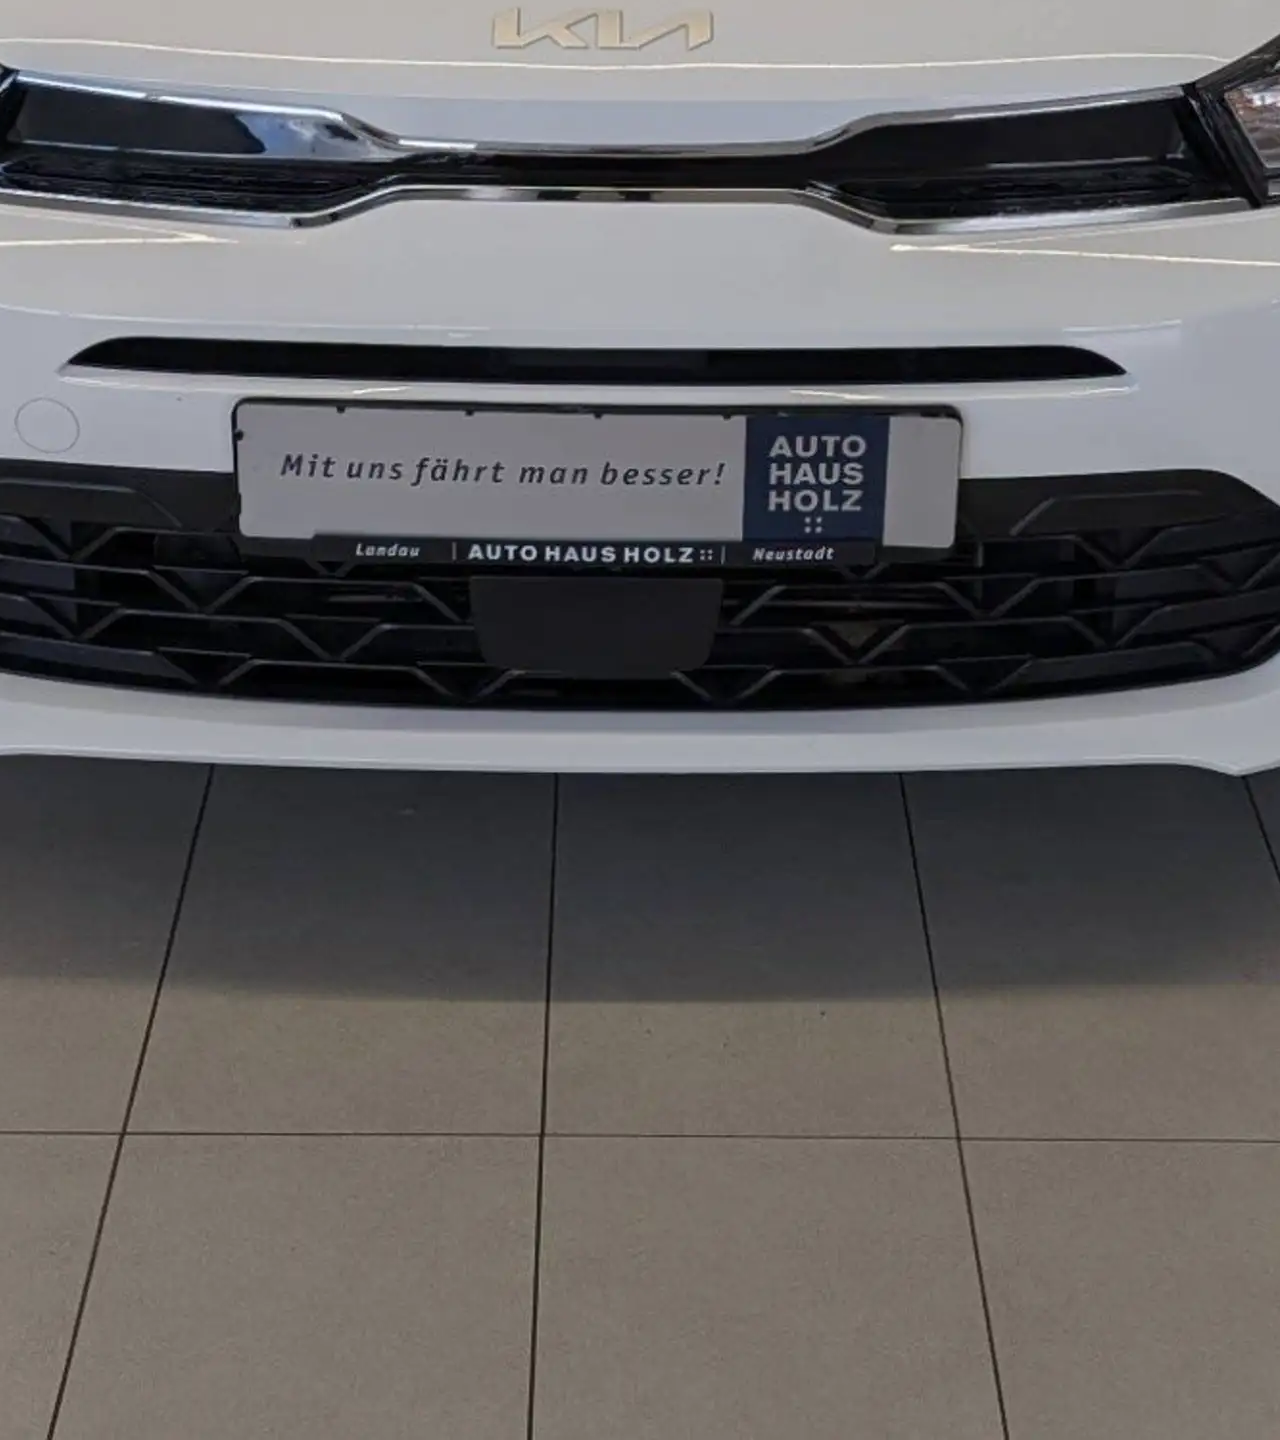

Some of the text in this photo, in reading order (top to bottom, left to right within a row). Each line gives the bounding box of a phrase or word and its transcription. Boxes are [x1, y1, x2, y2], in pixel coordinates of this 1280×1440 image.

[491, 6, 713, 51] KIA
[769, 435, 867, 458] AUTO
[280, 454, 726, 487] Mit uns fährt man besser!
[769, 462, 865, 486] HAUS
[767, 489, 864, 512] HOLZ
[355, 543, 836, 563] Landau AUTO HAUS HOLZ Neustadt
